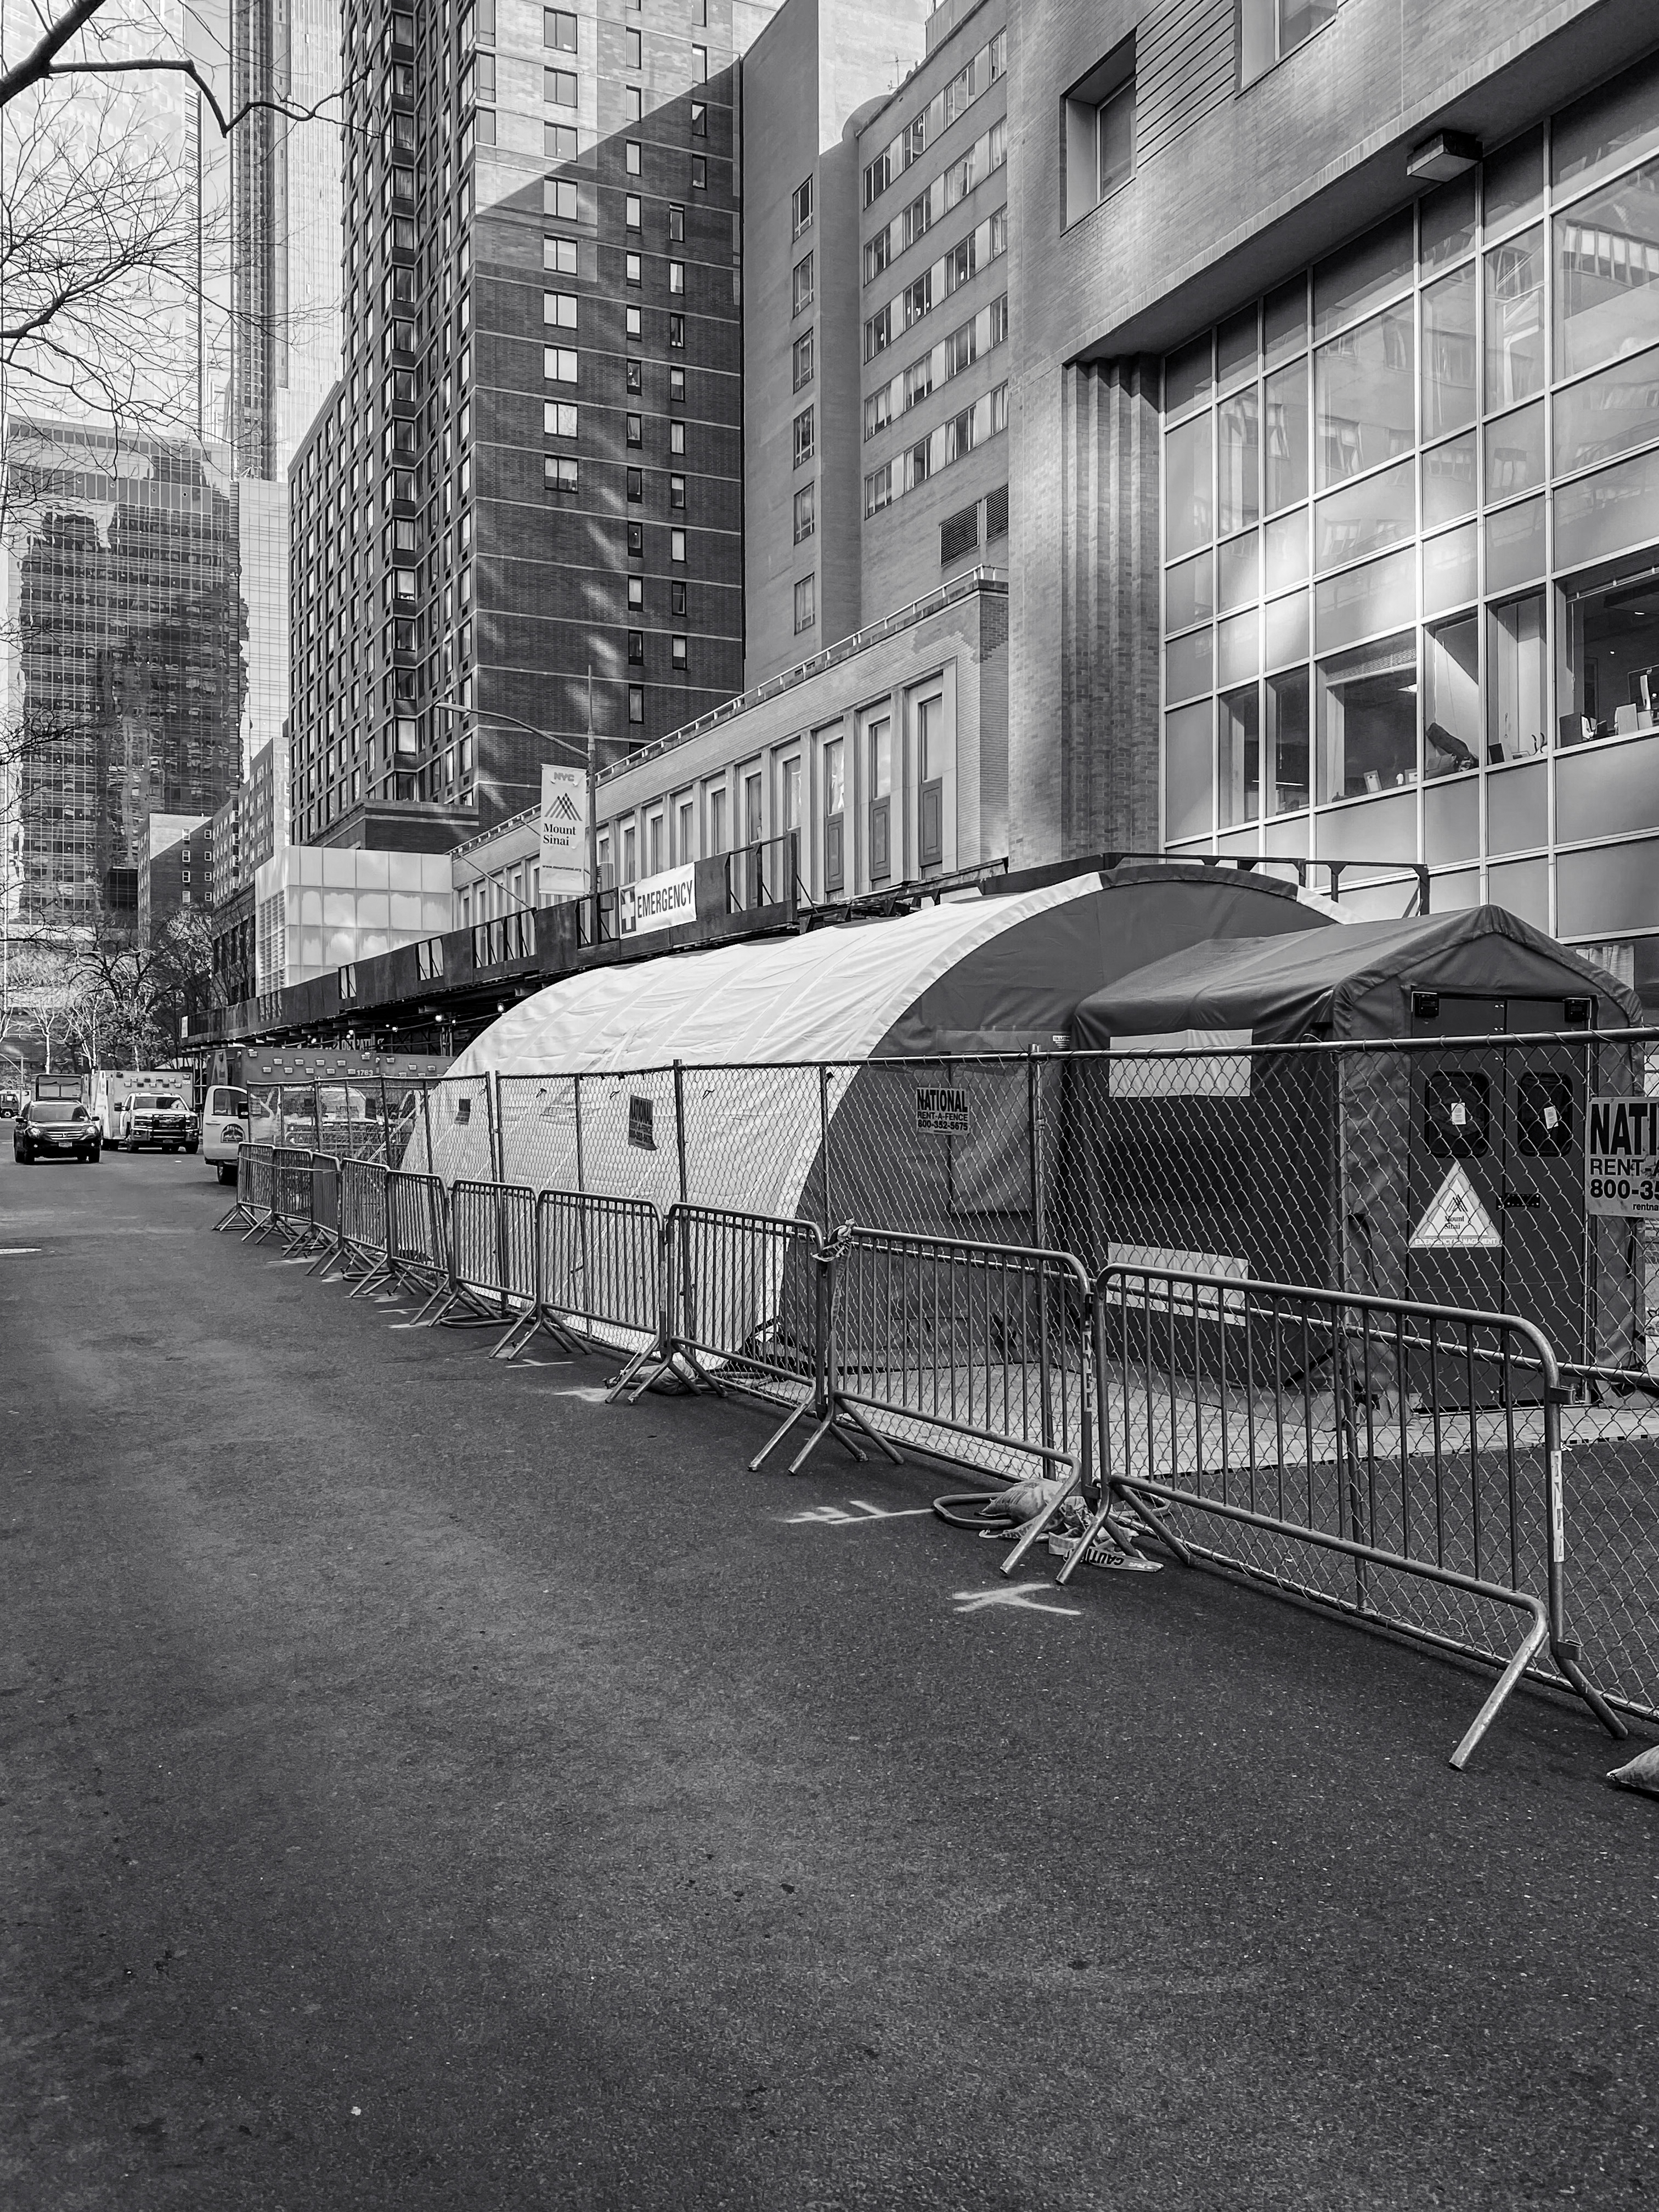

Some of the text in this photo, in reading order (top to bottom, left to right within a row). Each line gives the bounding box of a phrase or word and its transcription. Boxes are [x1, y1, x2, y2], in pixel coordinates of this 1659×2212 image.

[554, 772, 574, 782] NYC
[543, 823, 576, 836] Mount
[543, 834, 569, 846] Sinai
[637, 880, 692, 918] EMERGENCY
[917, 1089, 968, 1113] NATIONAL
[917, 1111, 968, 1121] RENT-A-FENCE
[918, 1119, 968, 1131] 800-352-5675
[1590, 1103, 1657, 1155] NATI
